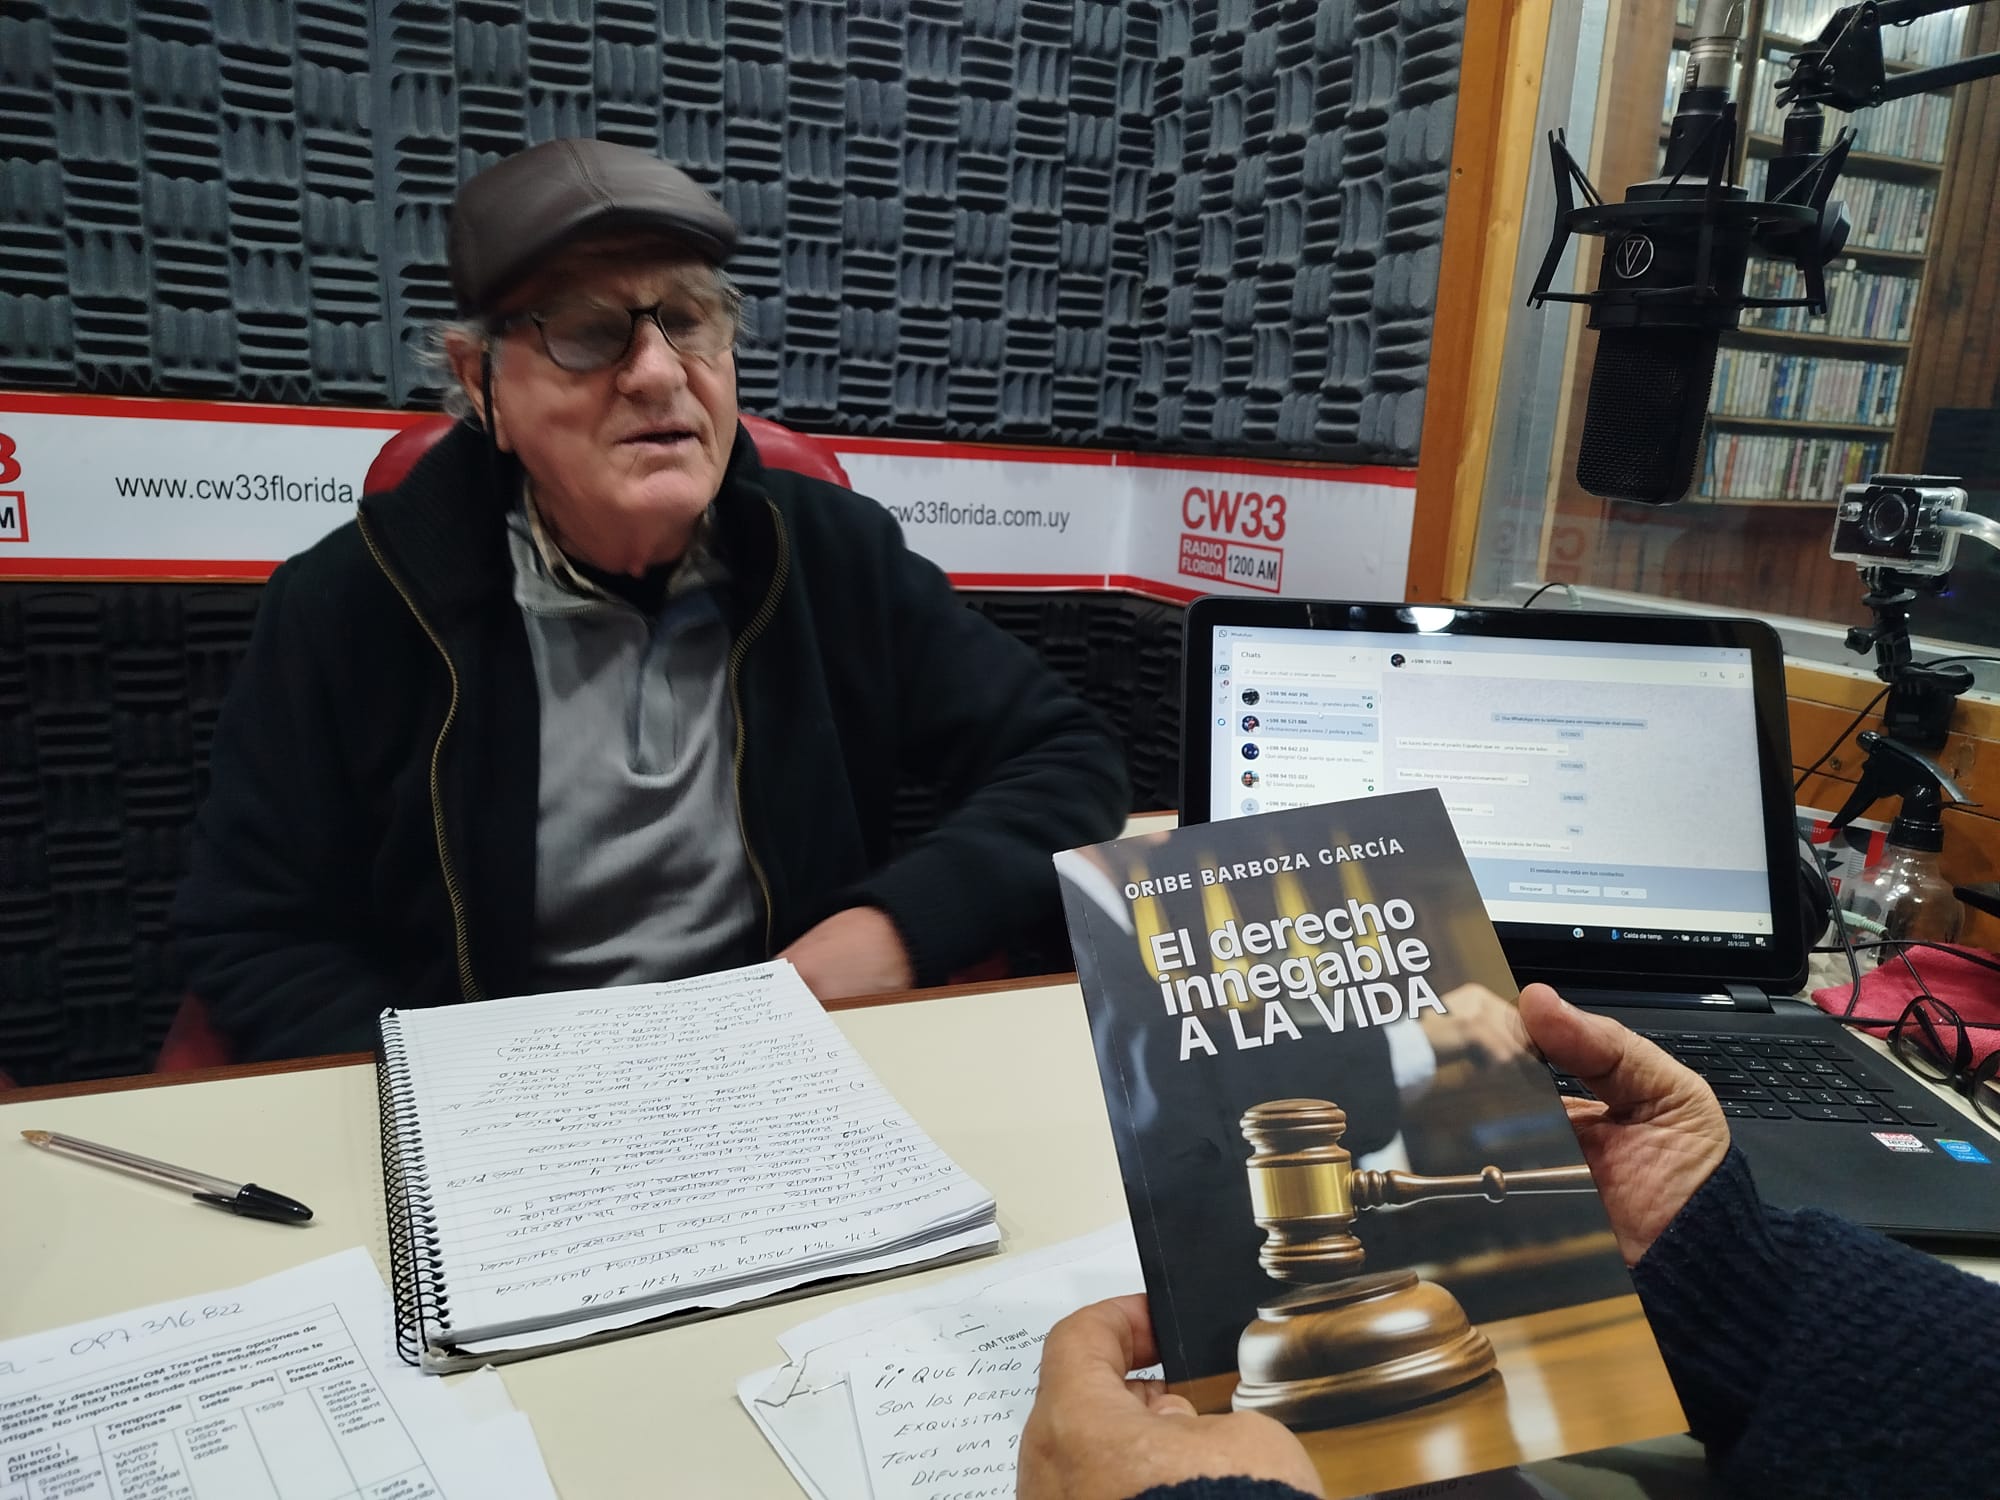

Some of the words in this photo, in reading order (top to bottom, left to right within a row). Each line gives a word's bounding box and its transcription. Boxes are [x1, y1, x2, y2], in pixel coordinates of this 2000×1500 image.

[1182, 486, 1286, 541] CW33
[1183, 539, 1223, 559] RADIO
[1182, 557, 1223, 577] FLORIDA
[1228, 554, 1254, 576] 1200
[1257, 560, 1277, 581] AM
[1124, 874, 1193, 901] ORIBE
[1201, 852, 1310, 887] BARBOZA
[1317, 837, 1405, 866] GARCÍA
[1149, 927, 1197, 972] El
[1209, 898, 1415, 961] derecho
[1157, 935, 1432, 1017] innegable
[1178, 1016, 1219, 1062] A
[1228, 1000, 1303, 1051] LA
[1310, 975, 1448, 1035] VIDA
[978, 1340, 998, 1352] OM
[998, 1328, 1029, 1345] Travel
[1018, 1341, 1030, 1349] un
[70, 1376, 139, 1401] descansar
[143, 1367, 166, 1379] OM
[170, 1354, 208, 1371] Travel
[211, 1346, 242, 1359] tiene
[246, 1330, 299, 1349] opciones
[303, 1325, 317, 1334] de
[286, 1360, 324, 1376] Precio
[328, 1355, 342, 1363] en
[289, 1370, 318, 1383] base
[322, 1359, 354, 1374] doble
[52, 1418, 72, 1428] No
[75, 1400, 128, 1421] importa
[144, 1384, 185, 1399] donde
[189, 1367, 237, 1386] quieras
[256, 1346, 310, 1366] nosotros
[312, 1341, 323, 1349] te
[53, 1403, 78, 1416] que
[82, 1394, 107, 1407] hay
[110, 1379, 159, 1396] hoteles
[163, 1367, 191, 1381] solo
[195, 1360, 222, 1373] para
[226, 1343, 279, 1362] adultos?
[323, 1386, 356, 1400] sujeta
[105, 1403, 182, 1432] Temporada
[333, 1401, 381, 1421] moment
[348, 1415, 363, 1425] de
[121, 1418, 167, 1436] fechas
[187, 1430, 218, 1444] USD
[221, 1424, 238, 1432] en
[341, 1417, 385, 1436] reserva
[112, 1442, 158, 1459] Vuelos
[190, 1437, 222, 1452] base
[193, 1443, 229, 1460] doble
[956, 1439, 990, 1453] UNA
[7, 1453, 26, 1465] All
[8, 1453, 61, 1474] Directo
[115, 1453, 149, 1468] MVD
[118, 1460, 157, 1477] Punta
[38, 1468, 80, 1486] Salida
